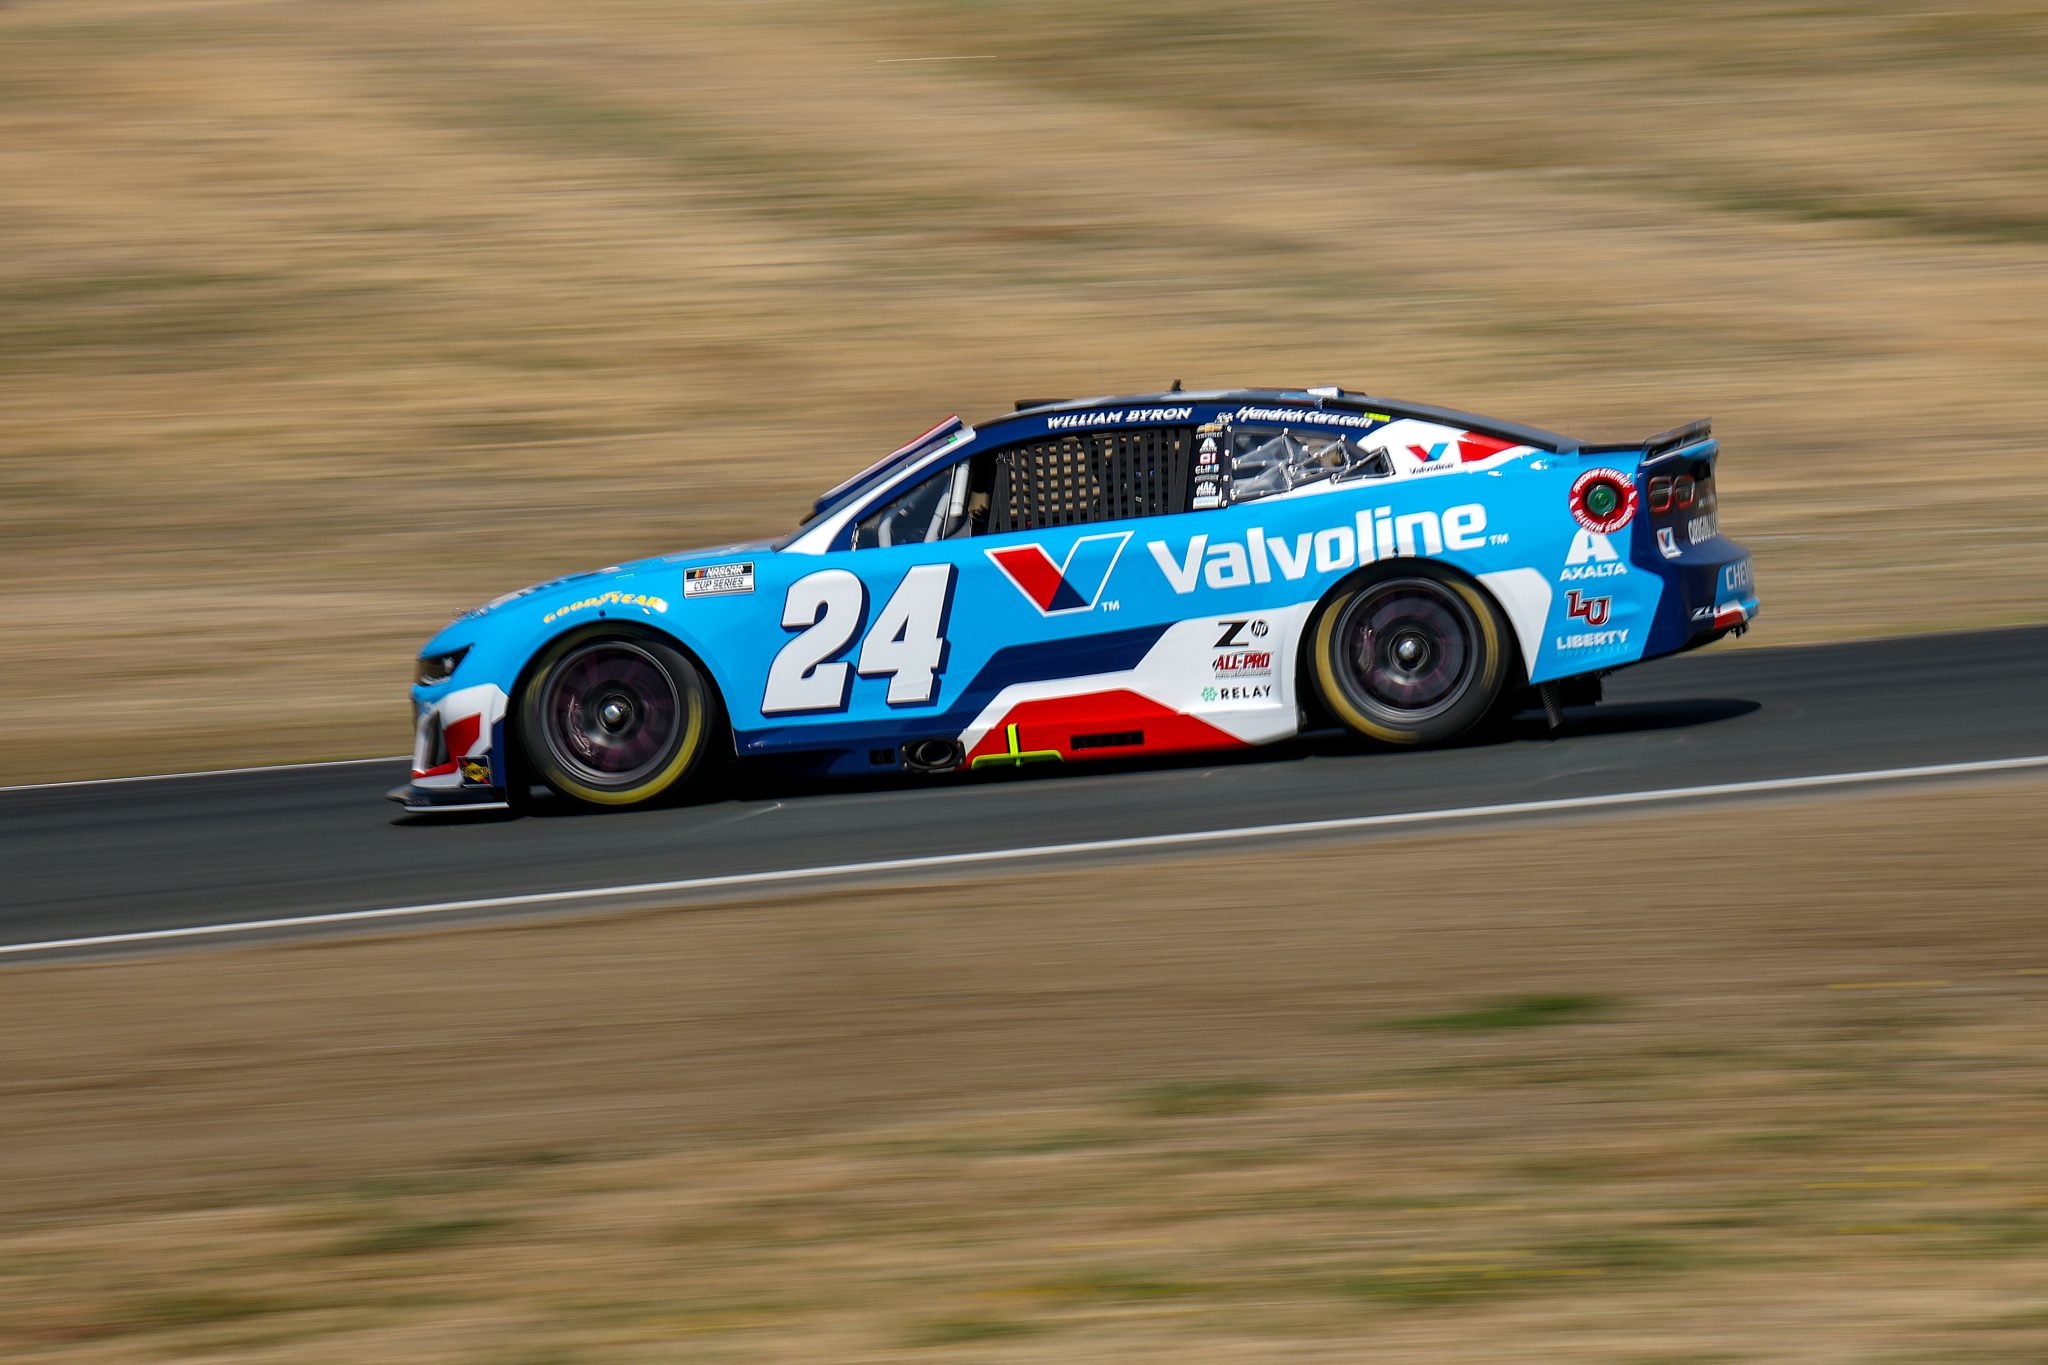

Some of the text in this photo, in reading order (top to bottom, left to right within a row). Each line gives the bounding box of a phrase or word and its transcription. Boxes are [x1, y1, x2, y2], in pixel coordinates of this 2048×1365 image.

[1048, 407, 1192, 429] WILLIAM BYRON
[1147, 502, 1509, 594] Valvoline TM
[706, 565, 744, 579] NASCAR
[1560, 562, 1628, 581] AXALTA
[694, 577, 744, 591] CUP SERIES
[543, 591, 659, 624] GOODYEAR
[1101, 600, 1120, 612] TM
[1564, 588, 1613, 626] LU
[761, 562, 959, 718] 24
[1213, 619, 1268, 647] Z hp
[1556, 629, 1628, 650] LIBERTY
[1213, 652, 1270, 670] ALL-PRO
[1220, 685, 1271, 699] RELAY
